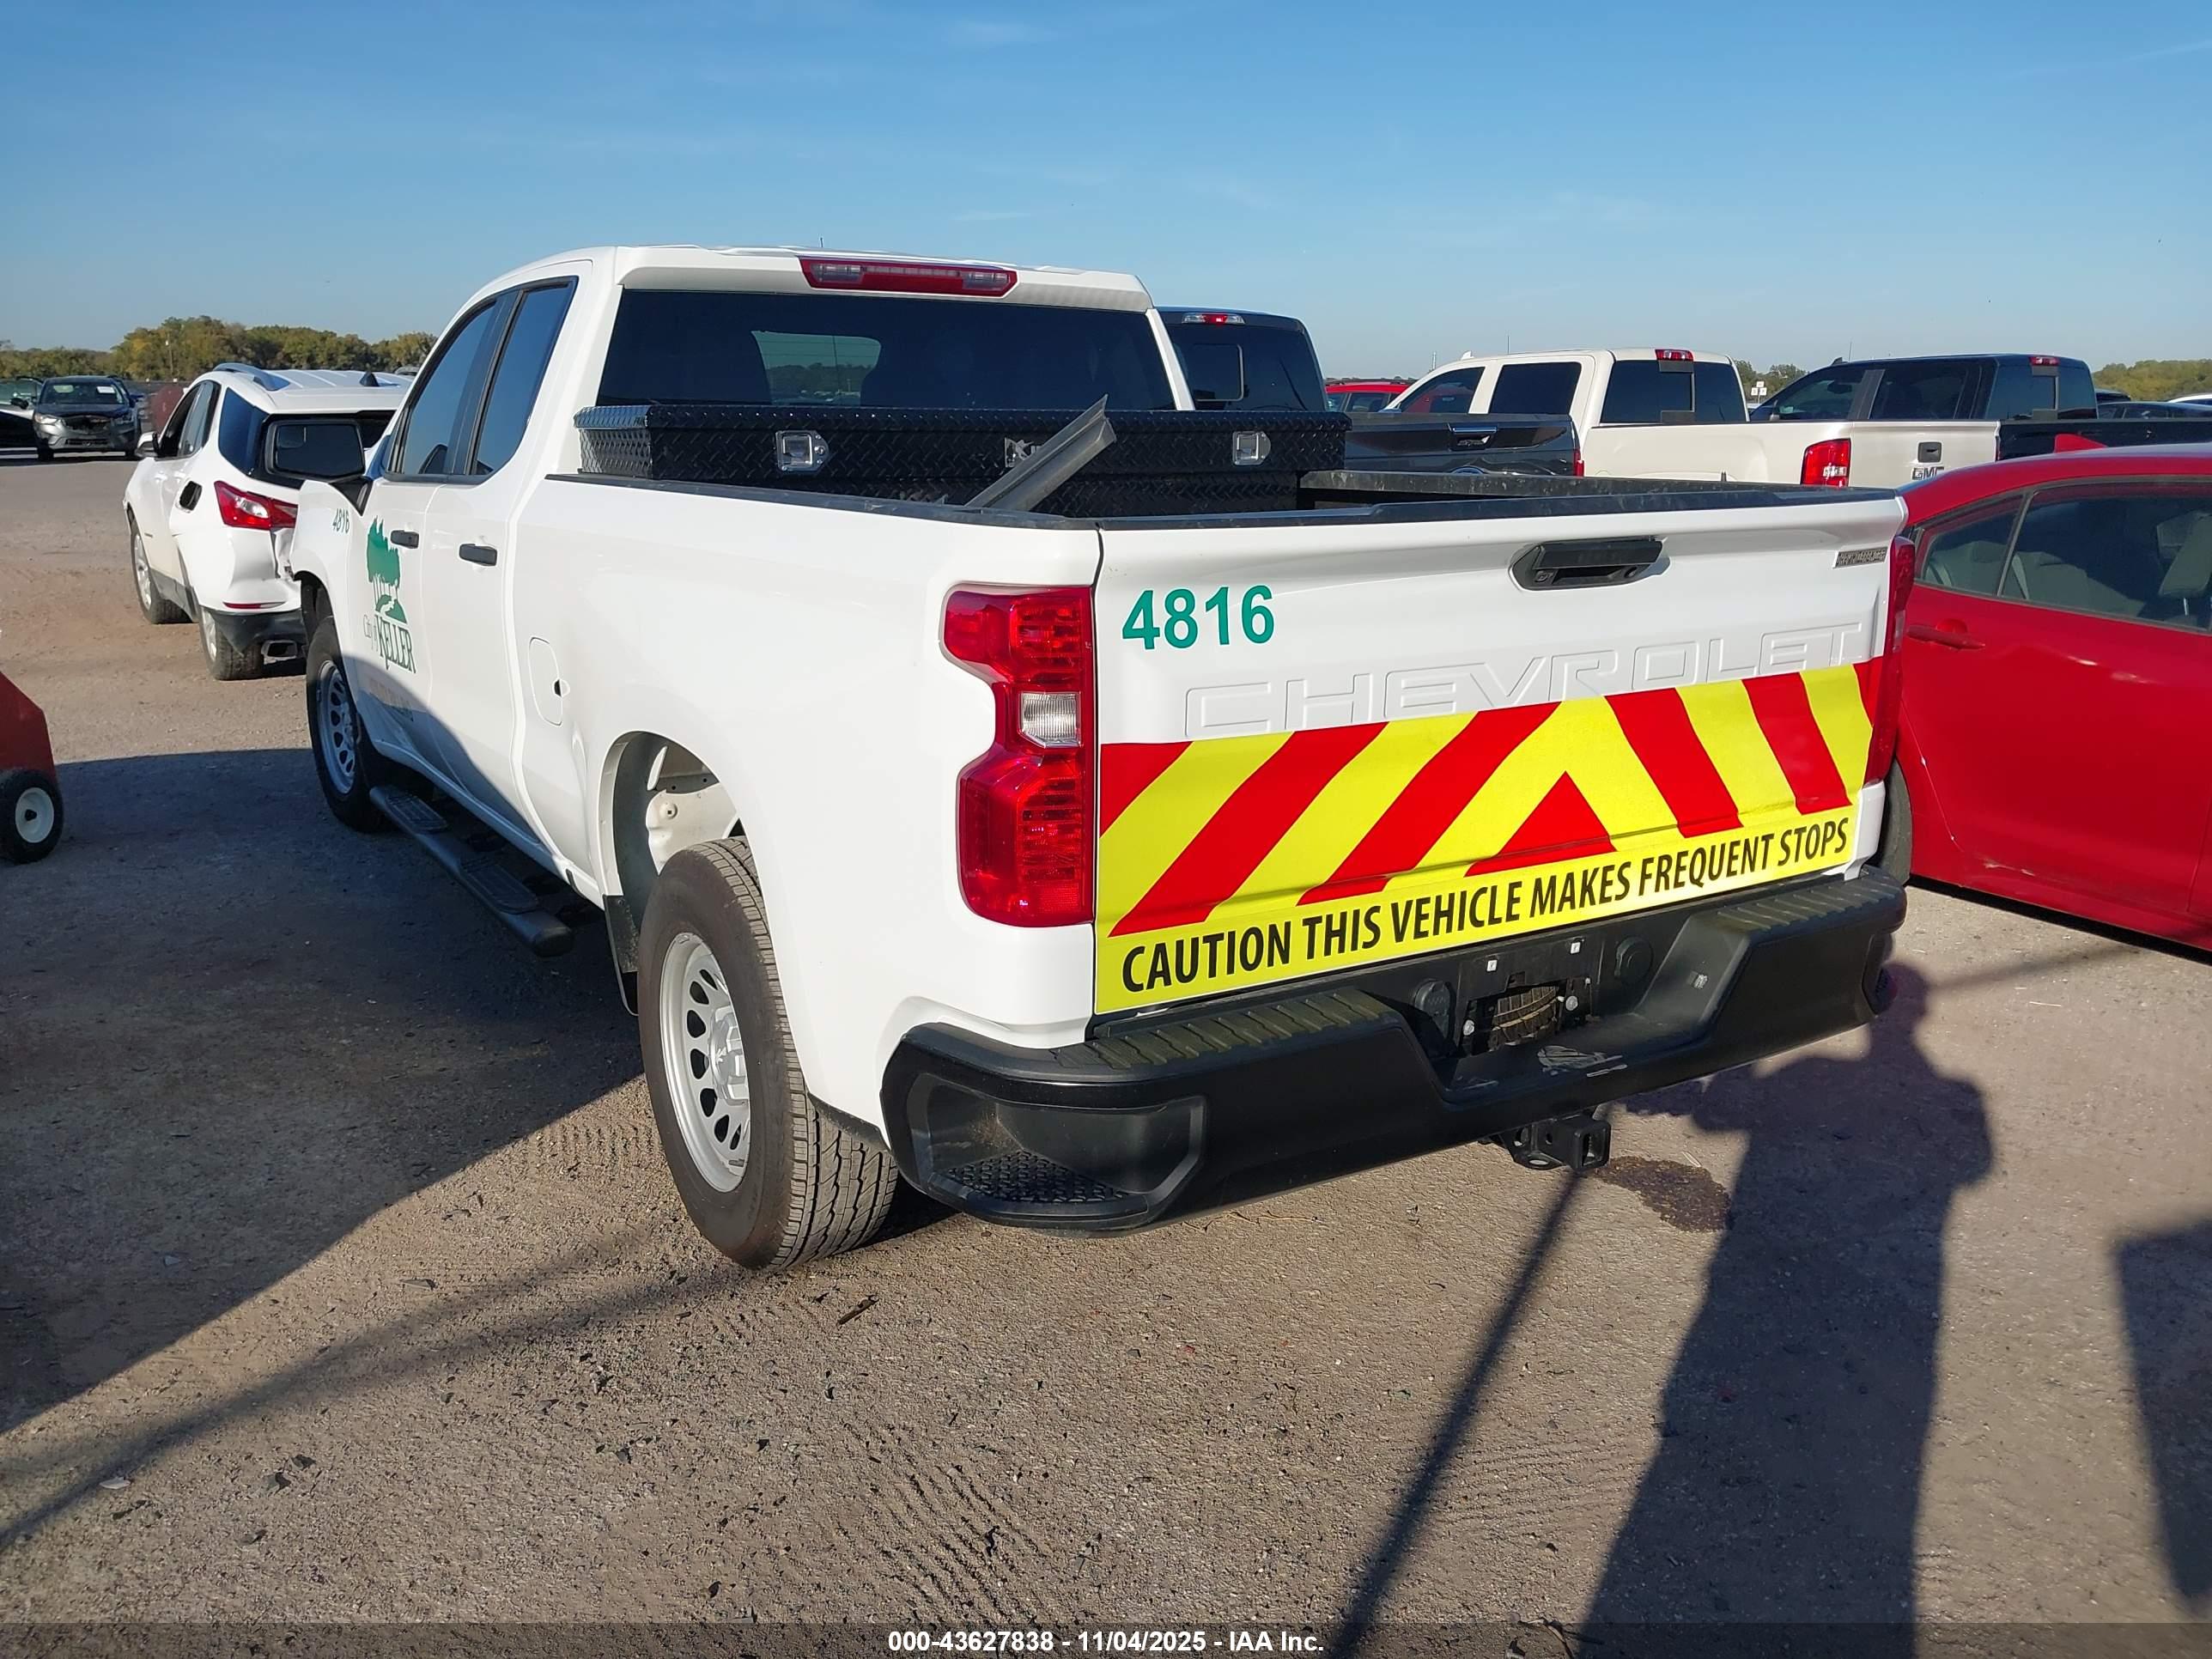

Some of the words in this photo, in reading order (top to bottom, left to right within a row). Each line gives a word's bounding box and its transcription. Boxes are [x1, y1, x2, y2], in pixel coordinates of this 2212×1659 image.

[332, 507, 350, 534] 4816
[374, 614, 416, 674] KELLER
[1121, 585, 1275, 651] 4816
[1184, 623, 1862, 738] CHEVROLET
[1122, 922, 1291, 993] CAUTION
[1302, 905, 1381, 960] THIS
[1390, 886, 1522, 944] VEHICLE
[1530, 864, 1632, 918] MAKES
[1639, 833, 1775, 896] FREQUENT
[1777, 817, 1849, 866] STOPS
